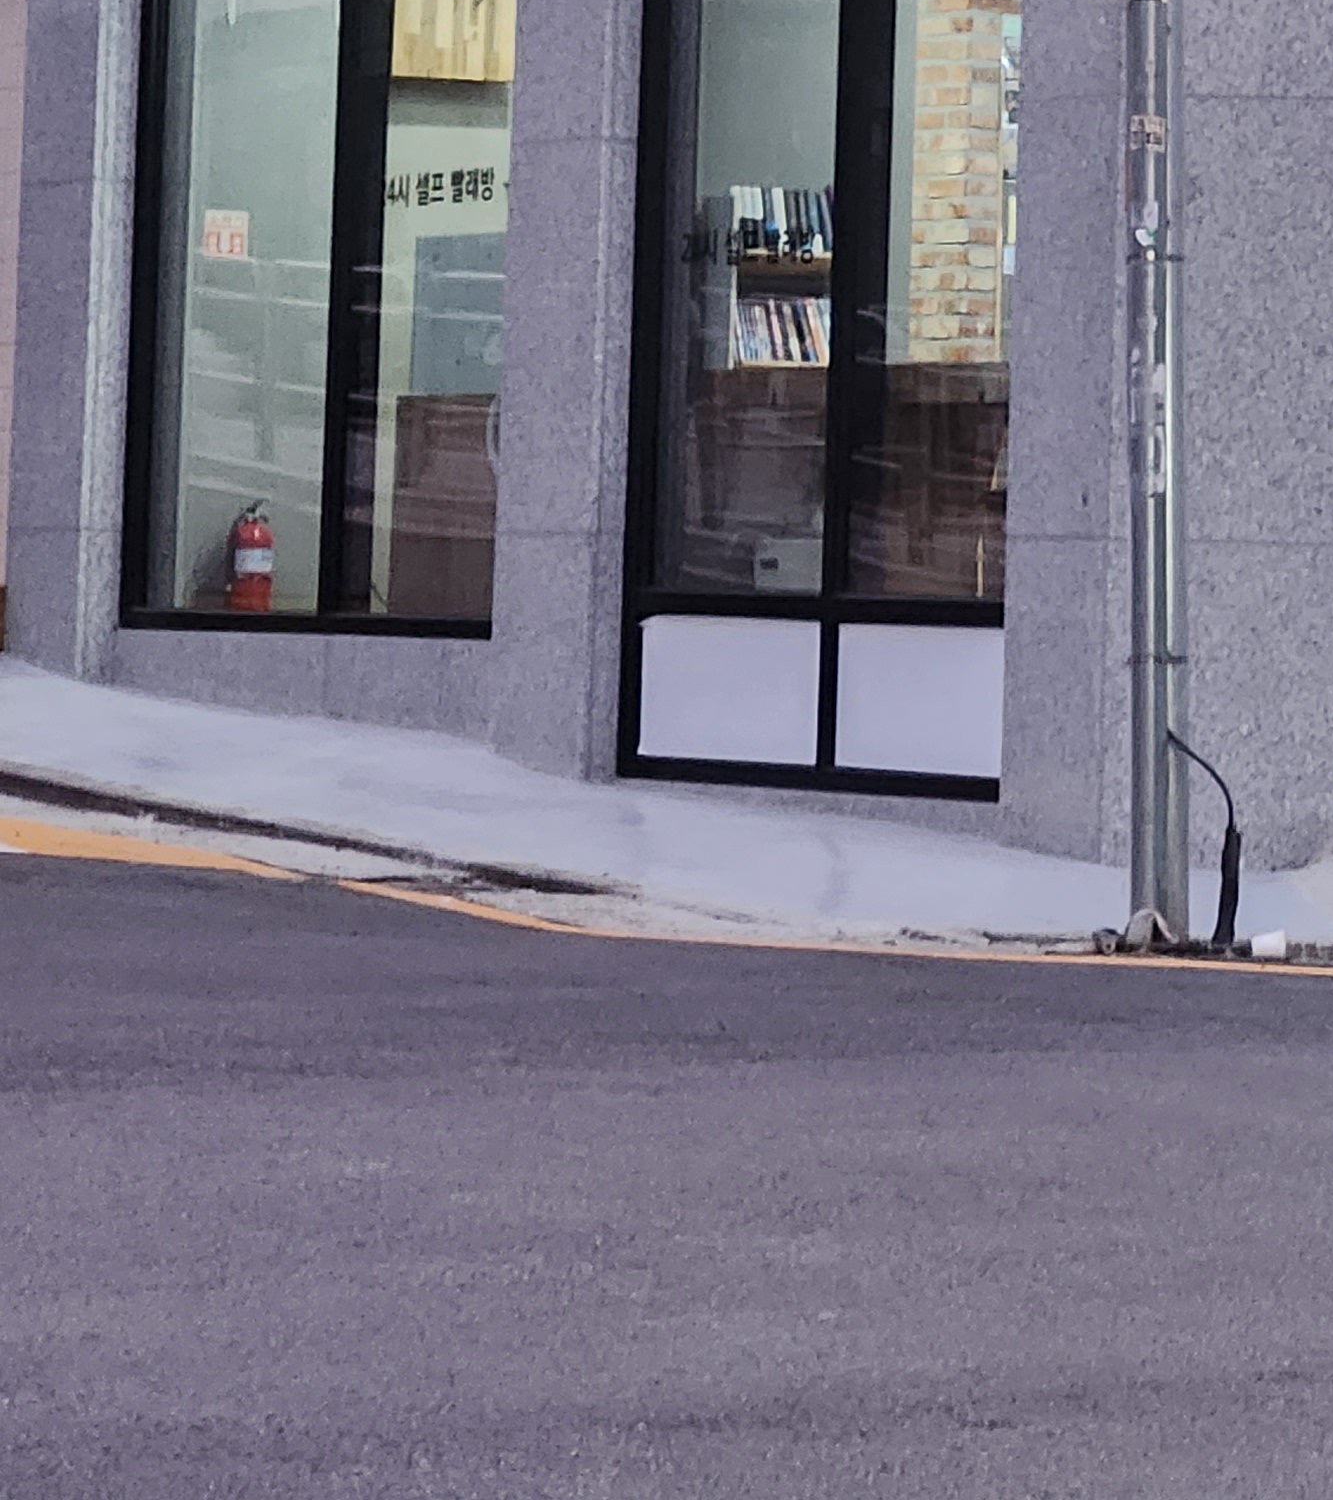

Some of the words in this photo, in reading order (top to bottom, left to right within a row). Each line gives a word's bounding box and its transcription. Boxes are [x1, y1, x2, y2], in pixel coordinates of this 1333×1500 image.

[386, 172, 411, 208] 4시
[415, 171, 445, 207] 셀프
[450, 166, 495, 203] 빨래방
